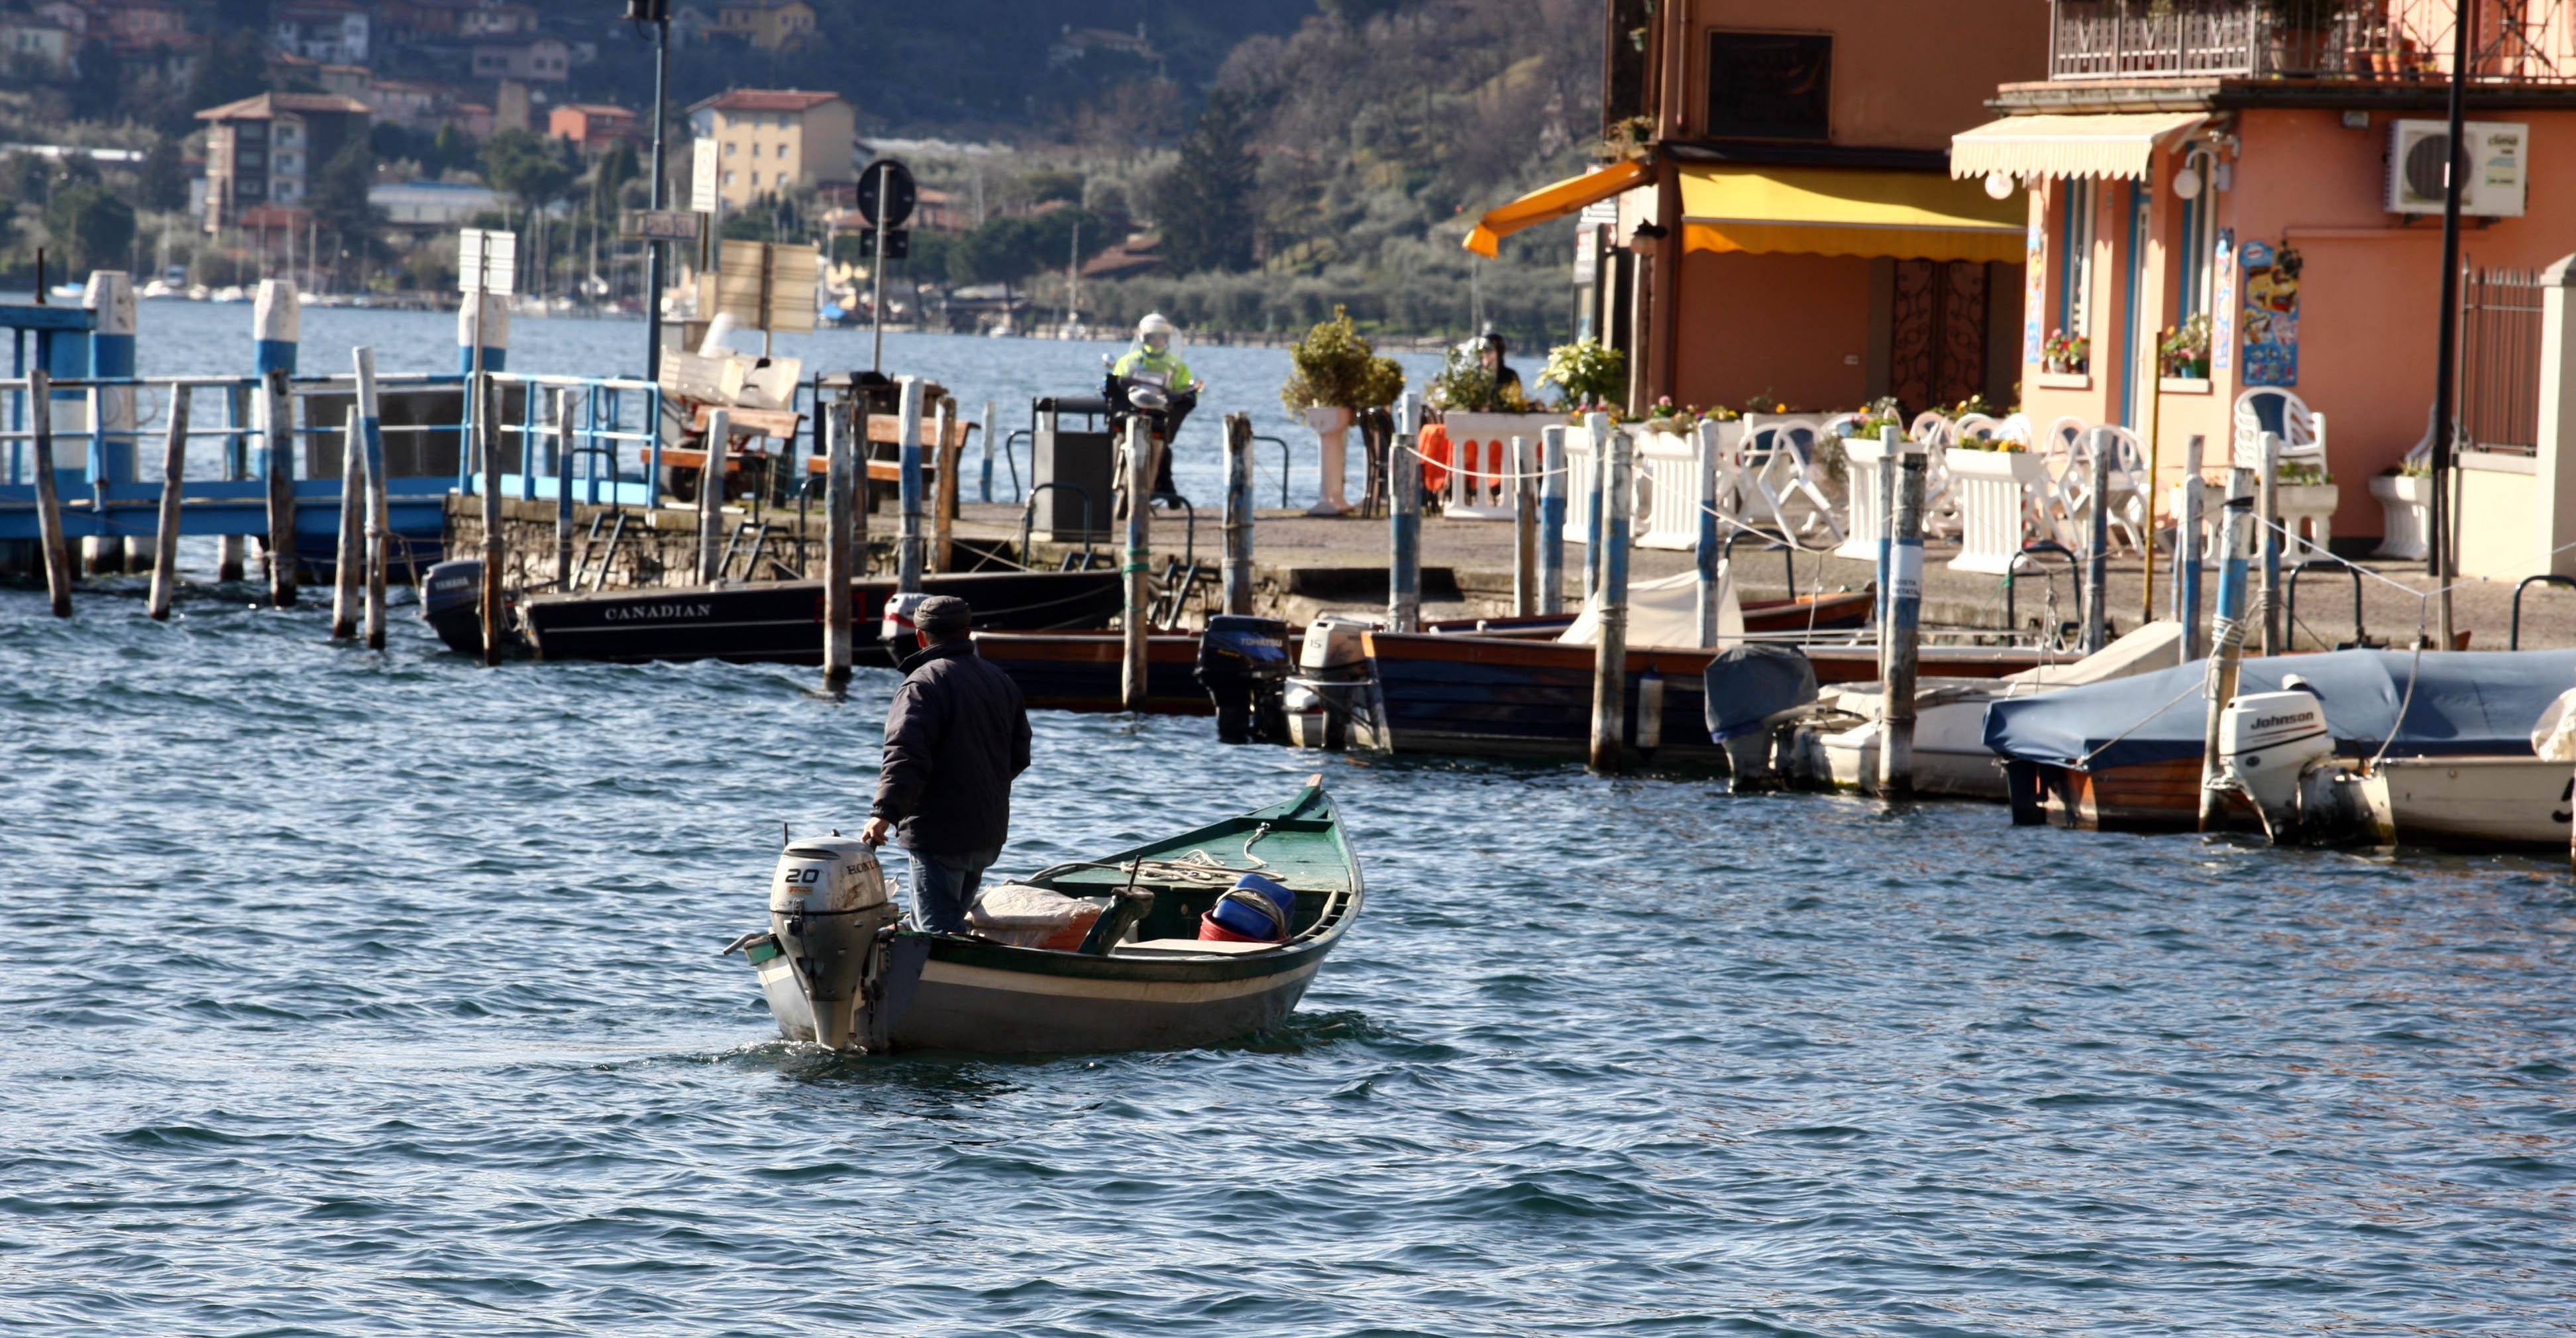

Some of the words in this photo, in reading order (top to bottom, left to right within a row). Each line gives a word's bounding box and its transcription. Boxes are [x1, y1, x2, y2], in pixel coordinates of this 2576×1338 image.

[605, 604, 711, 620] CANADIAN
[1240, 638, 1283, 648] TOHATSU
[2251, 712, 2314, 730] Johnson
[785, 869, 820, 883] 20
